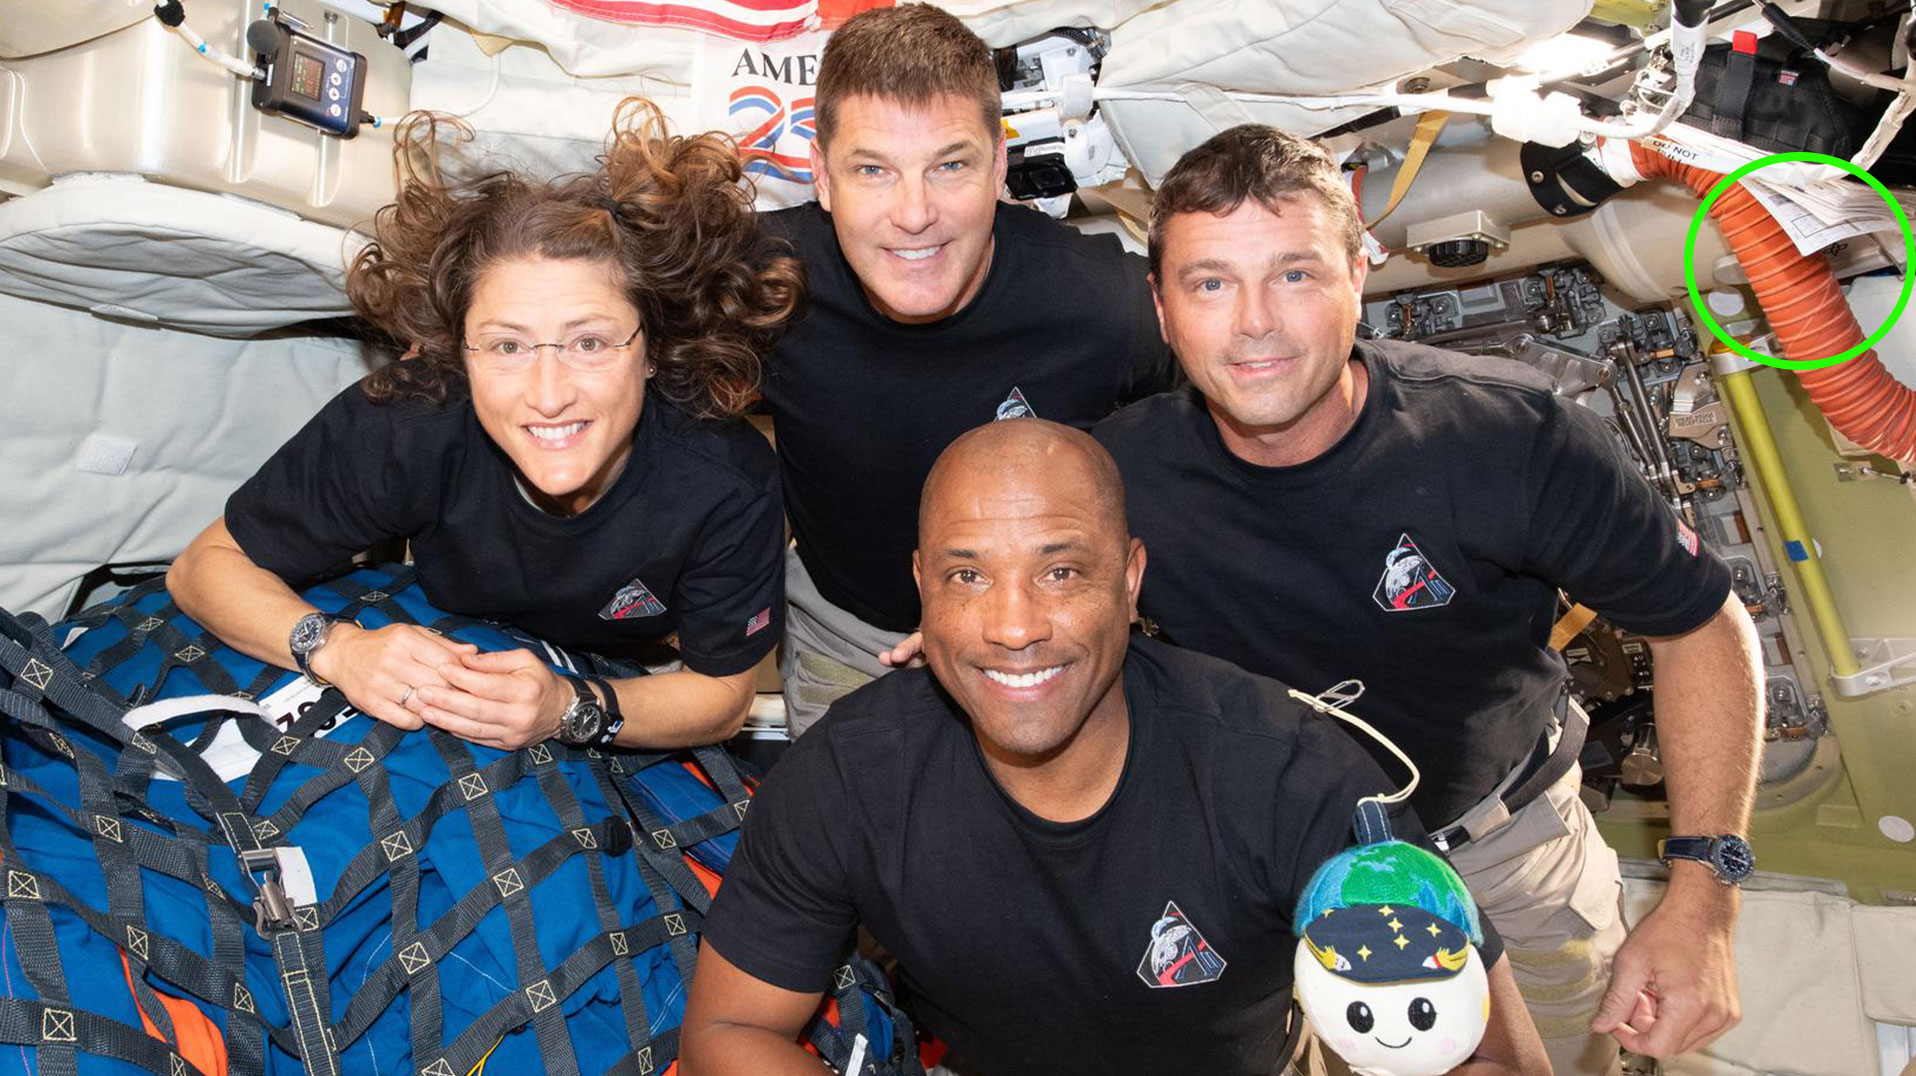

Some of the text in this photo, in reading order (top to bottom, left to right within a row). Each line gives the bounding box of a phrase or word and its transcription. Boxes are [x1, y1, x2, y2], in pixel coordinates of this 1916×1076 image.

[731, 47, 817, 86] AME
[1652, 140, 1671, 149] DO
[1673, 146, 1699, 161] NOT
